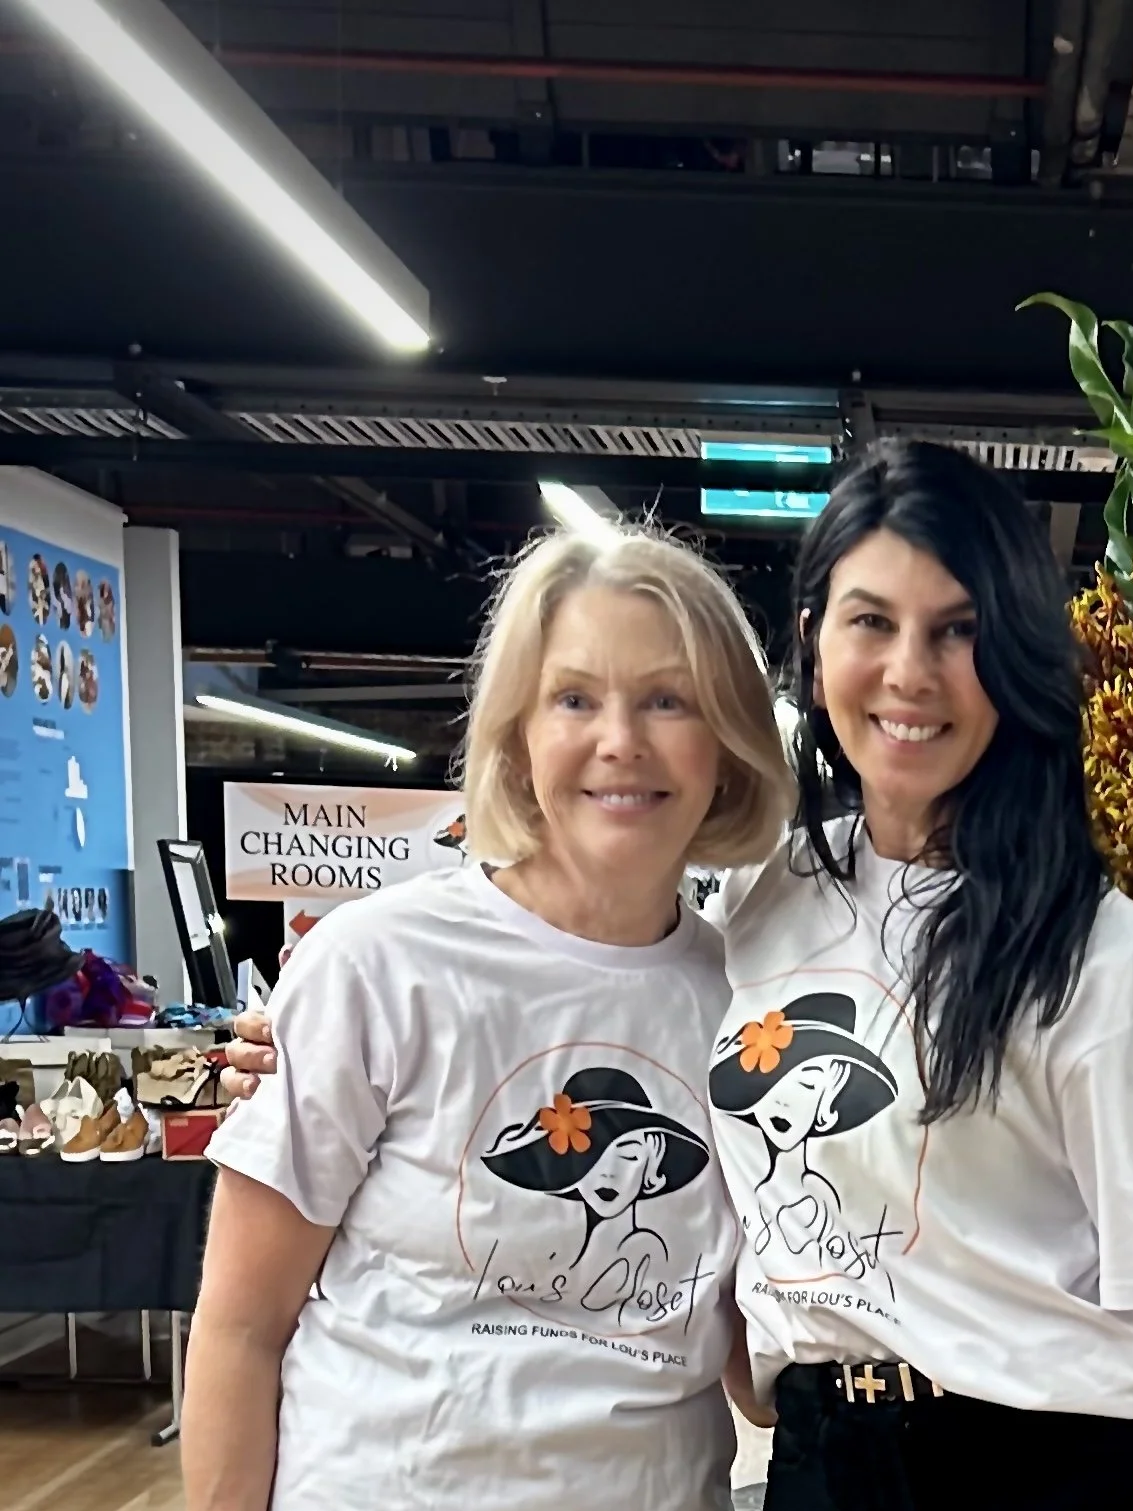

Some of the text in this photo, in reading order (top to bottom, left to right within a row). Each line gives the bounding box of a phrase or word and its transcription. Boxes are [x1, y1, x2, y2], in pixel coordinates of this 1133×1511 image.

[282, 802, 367, 828] MAIN
[240, 831, 410, 861] CHANGING
[270, 862, 382, 889] ROOMS
[580, 1252, 715, 1337] Closet
[787, 1290, 808, 1304] FOR
[810, 1291, 853, 1308] LOU'S
[471, 1323, 688, 1367] RAISING FUNDS FOR LOU'S PLACE
